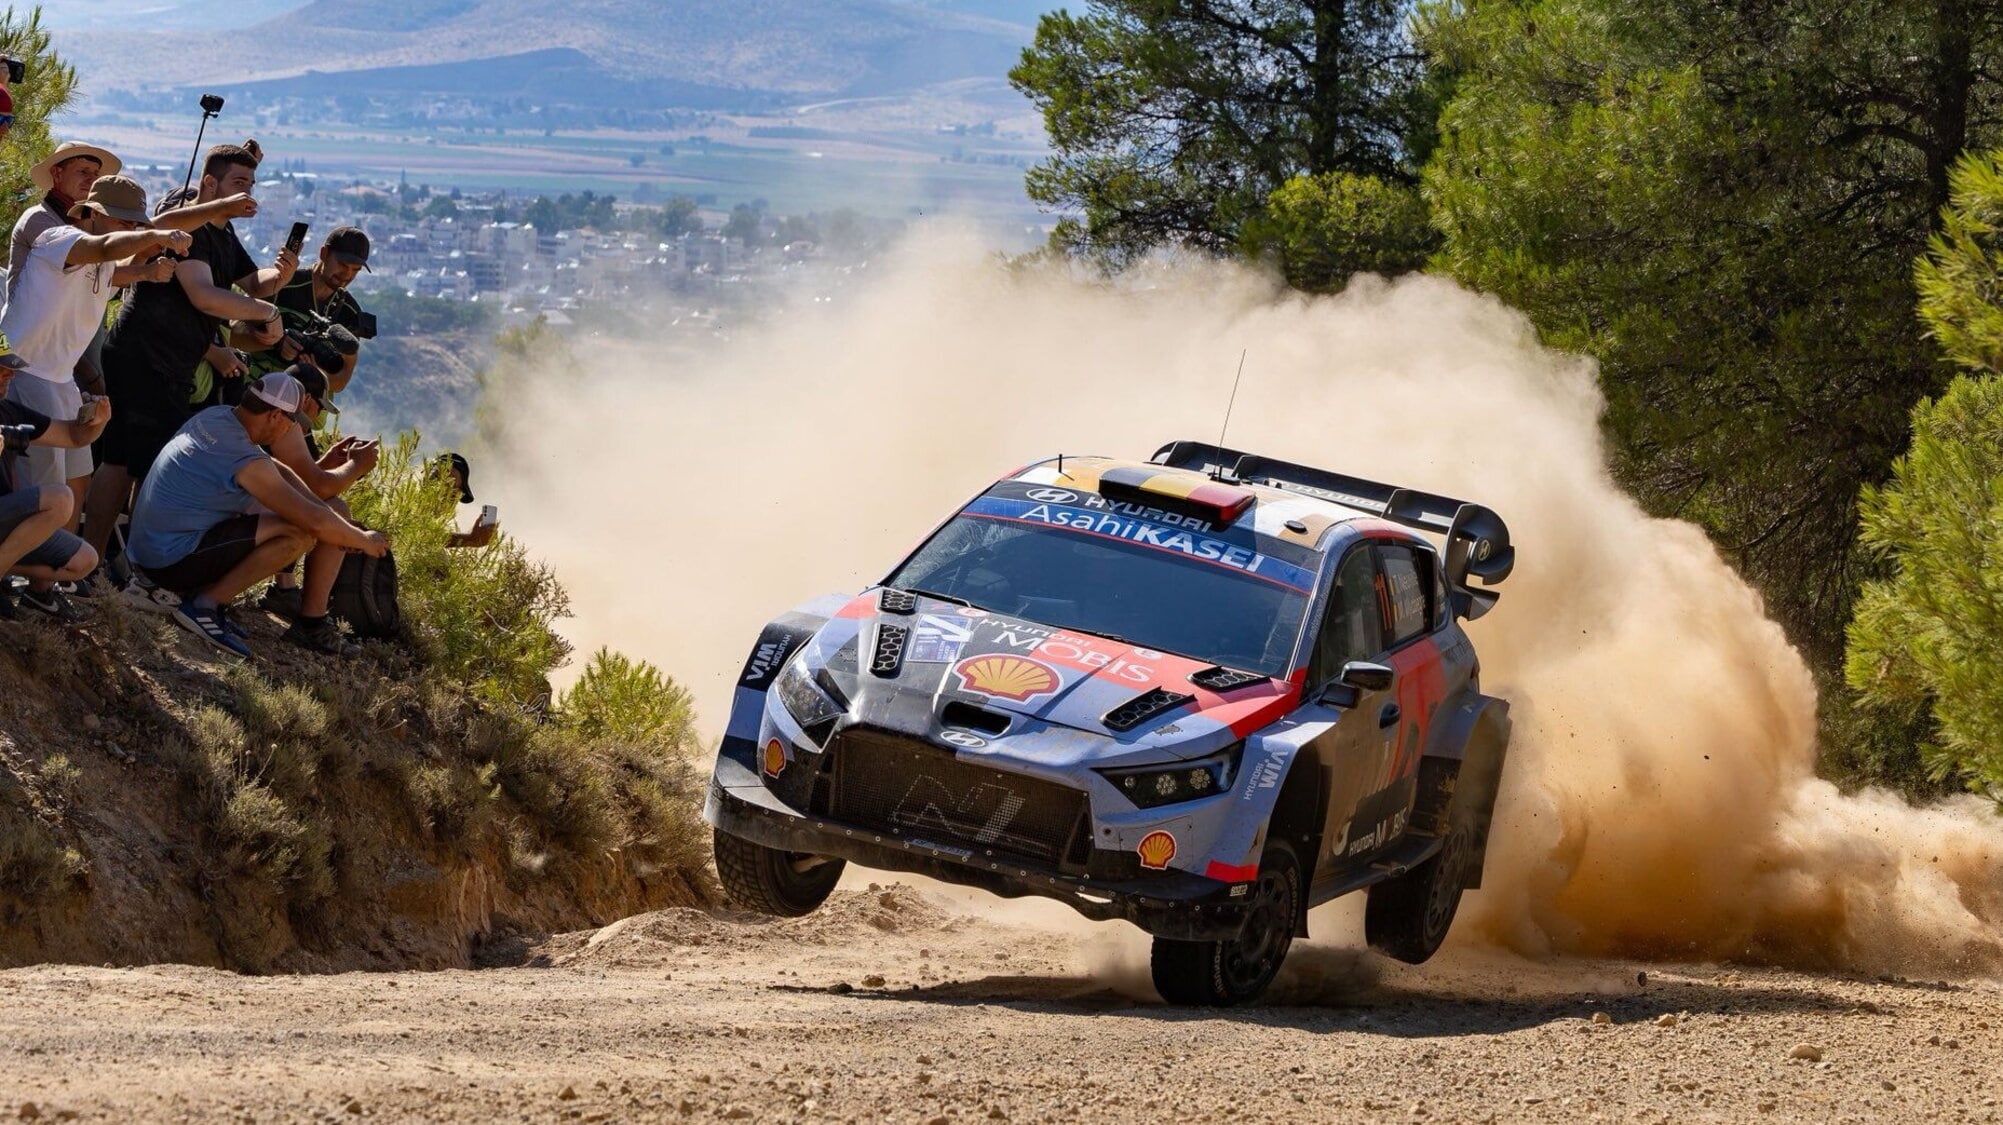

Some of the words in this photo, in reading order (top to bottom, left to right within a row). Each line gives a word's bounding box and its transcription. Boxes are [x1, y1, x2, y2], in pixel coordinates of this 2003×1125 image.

[1085, 495, 1212, 533] HYUNDAI
[982, 618, 1092, 648] HYUNDAI
[746, 643, 778, 681] WIA
[992, 631, 1154, 683] MOBIS
[1243, 762, 1265, 801] HYUNDAI
[1258, 751, 1289, 789] WIA
